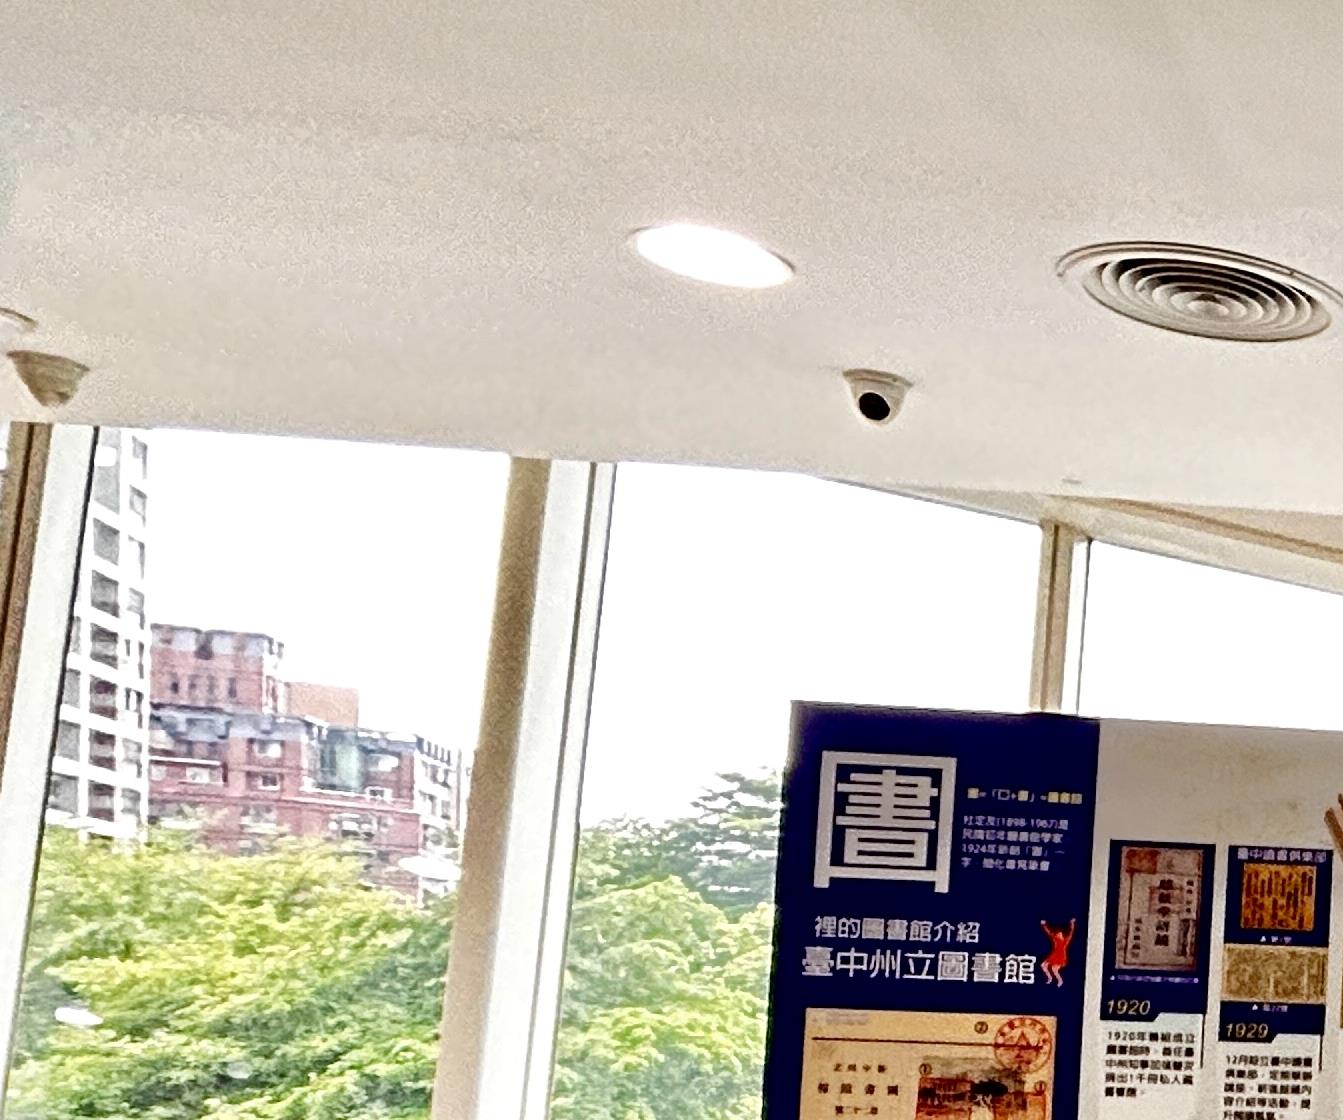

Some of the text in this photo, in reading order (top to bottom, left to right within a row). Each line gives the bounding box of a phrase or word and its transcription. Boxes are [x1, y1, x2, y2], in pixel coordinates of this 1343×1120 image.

[815, 916, 980, 943] 裡的圖書館介紹
[802, 946, 1036, 984] 臺中州立圖書館
[1107, 1000, 1151, 1015] 1920
[1226, 1023, 1268, 1039] 1929
